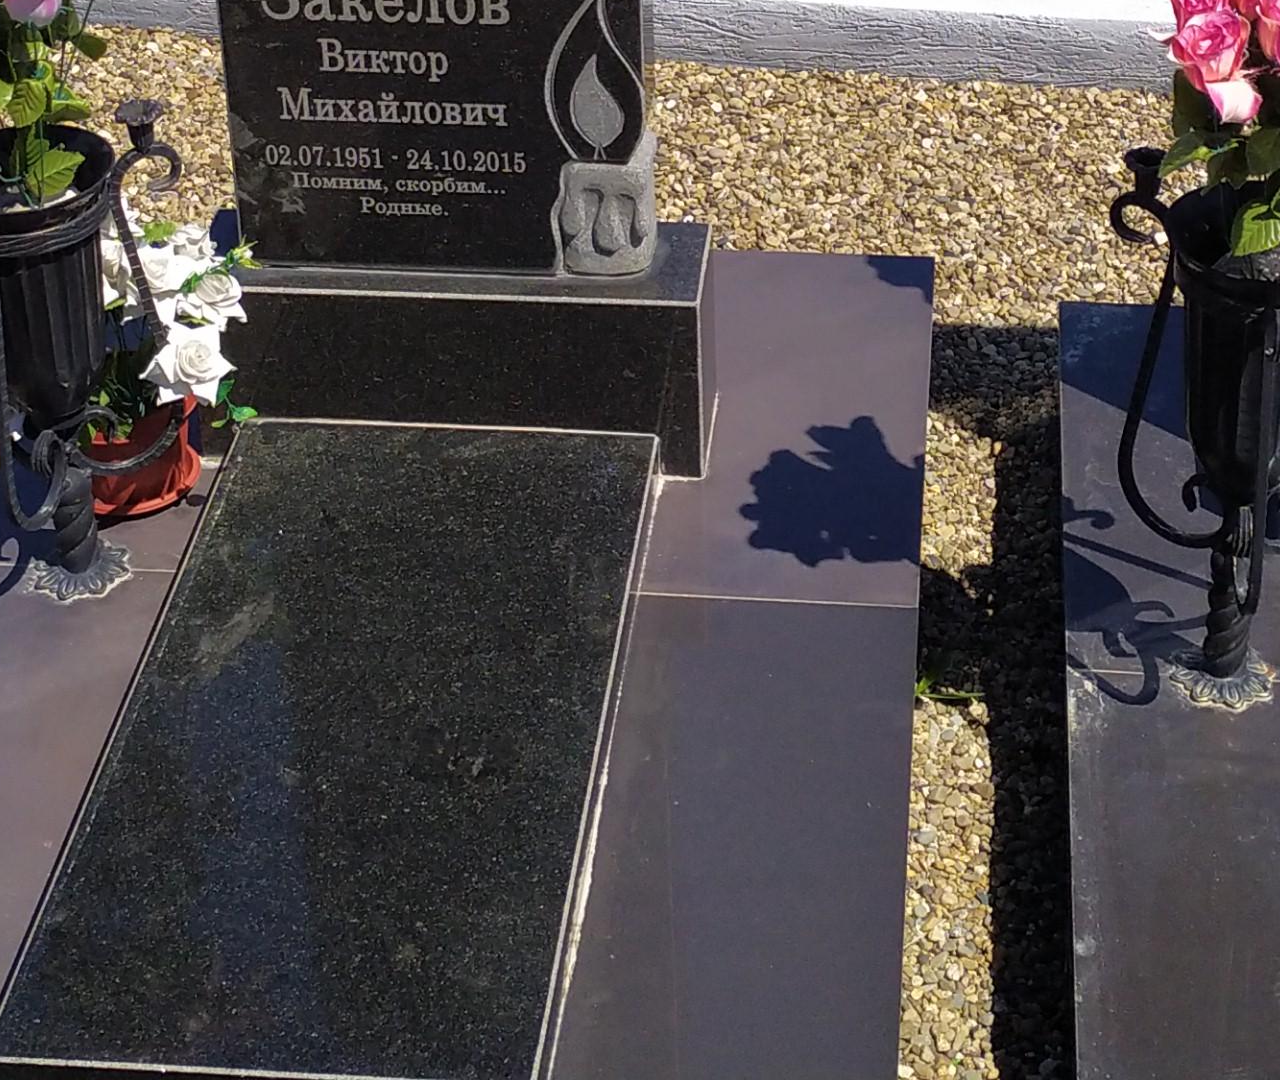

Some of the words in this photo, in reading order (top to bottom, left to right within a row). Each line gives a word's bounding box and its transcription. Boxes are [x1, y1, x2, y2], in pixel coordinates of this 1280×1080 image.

[317, 38, 449, 83] Виктор
[276, 86, 509, 128] Михайлович
[265, 145, 384, 169] 02.07.1951
[406, 149, 527, 174] 24.10.2015
[292, 171, 389, 193] Помним,
[395, 178, 506, 197] скорбим...
[360, 196, 449, 218] Родные.
